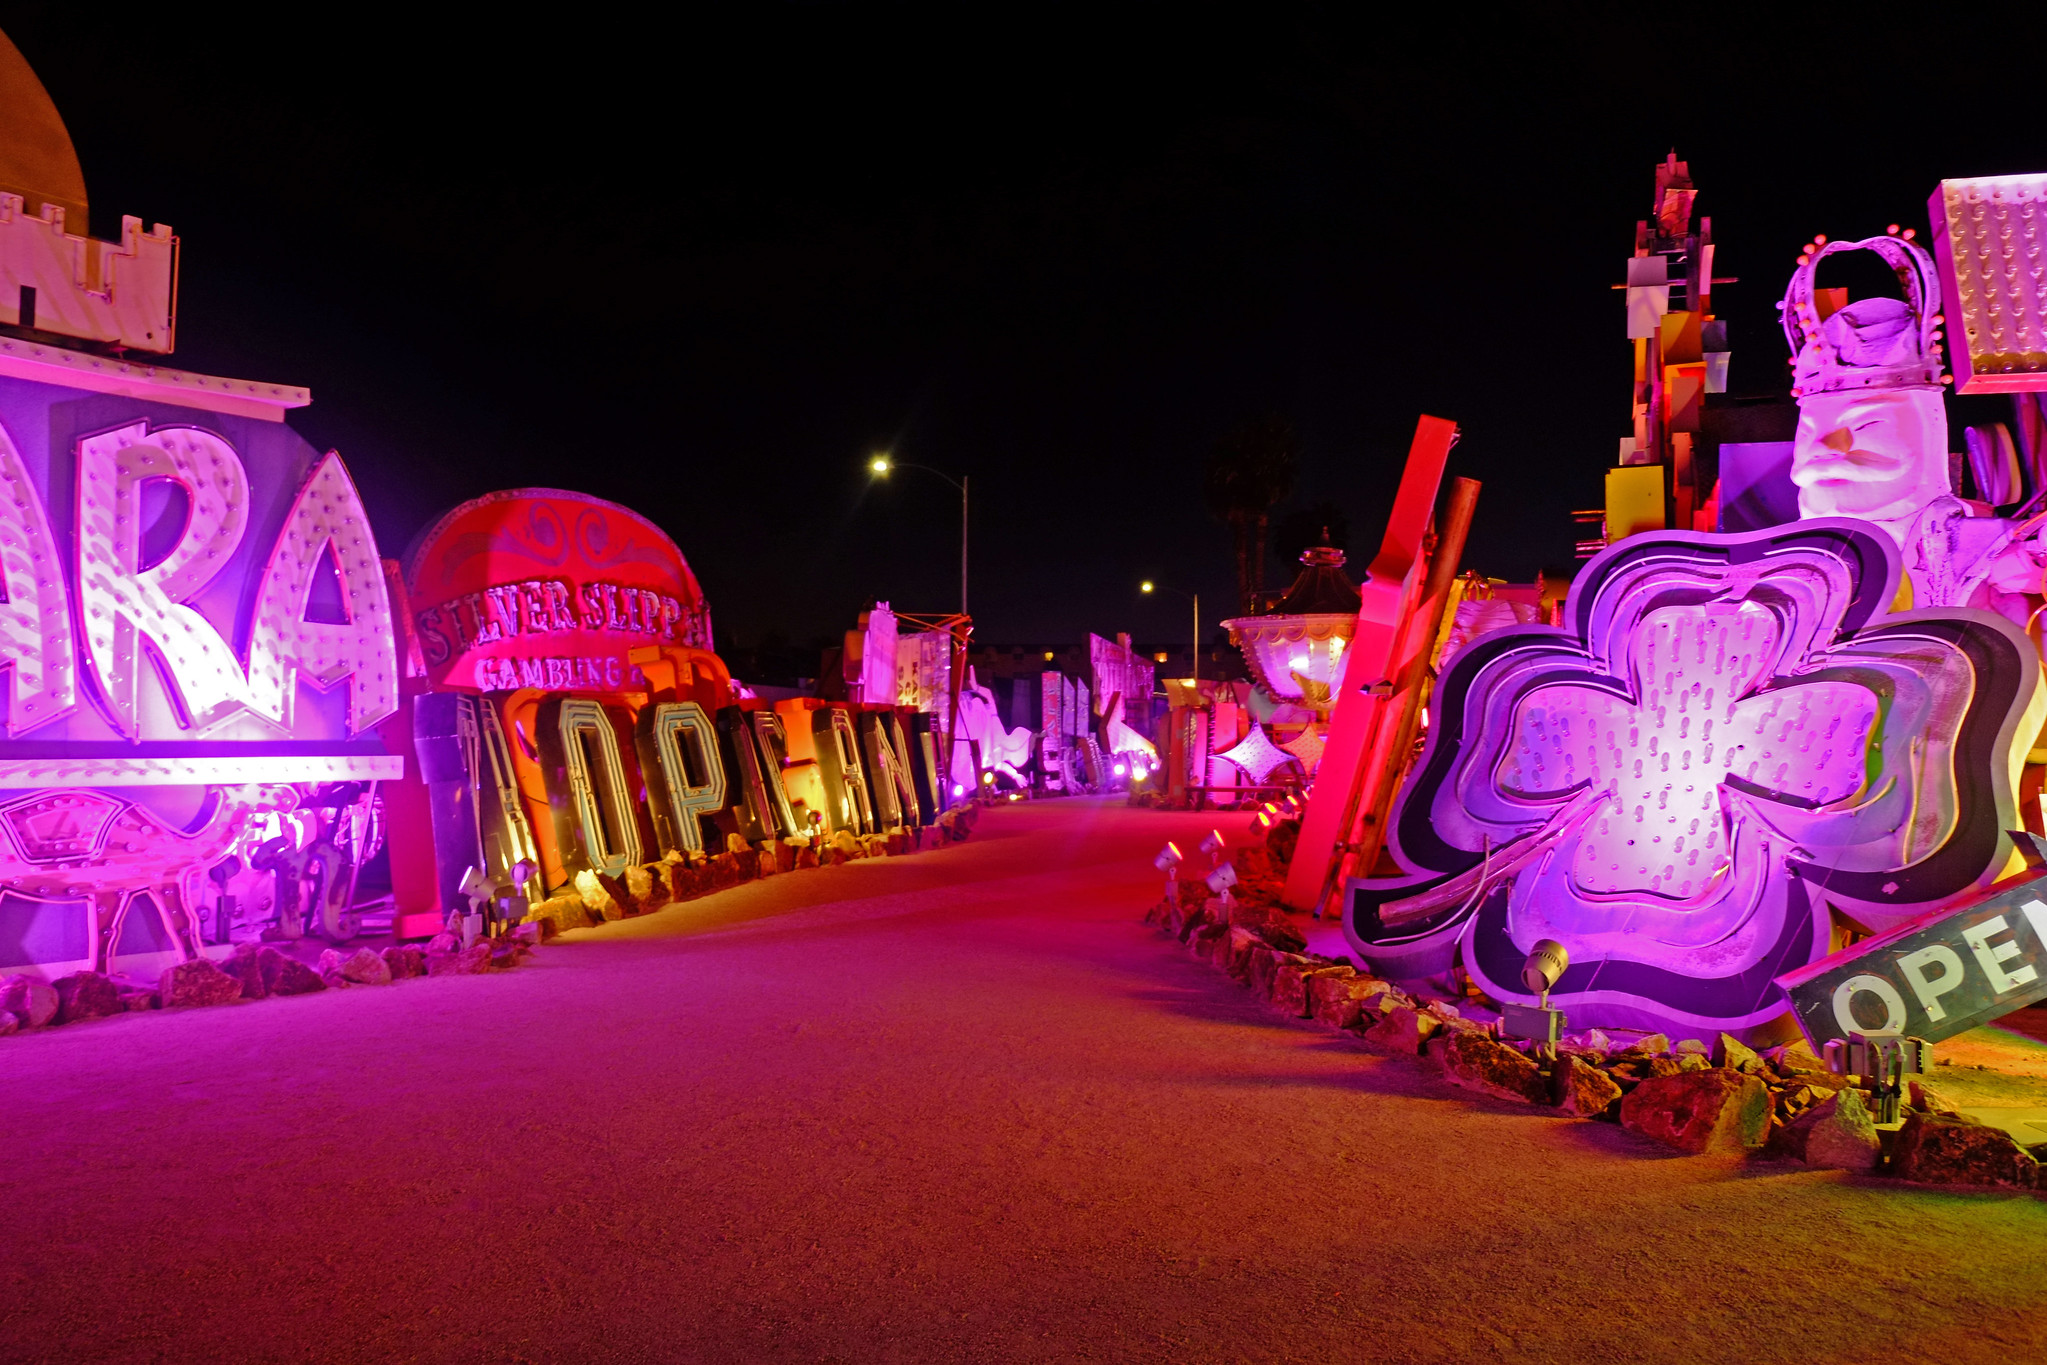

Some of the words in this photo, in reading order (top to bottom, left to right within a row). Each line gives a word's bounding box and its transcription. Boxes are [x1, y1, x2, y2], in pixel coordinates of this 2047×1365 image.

[415, 581, 576, 667] SILVER
[474, 655, 623, 692] GAMBLING
[1832, 899, 2047, 1037] OPE
